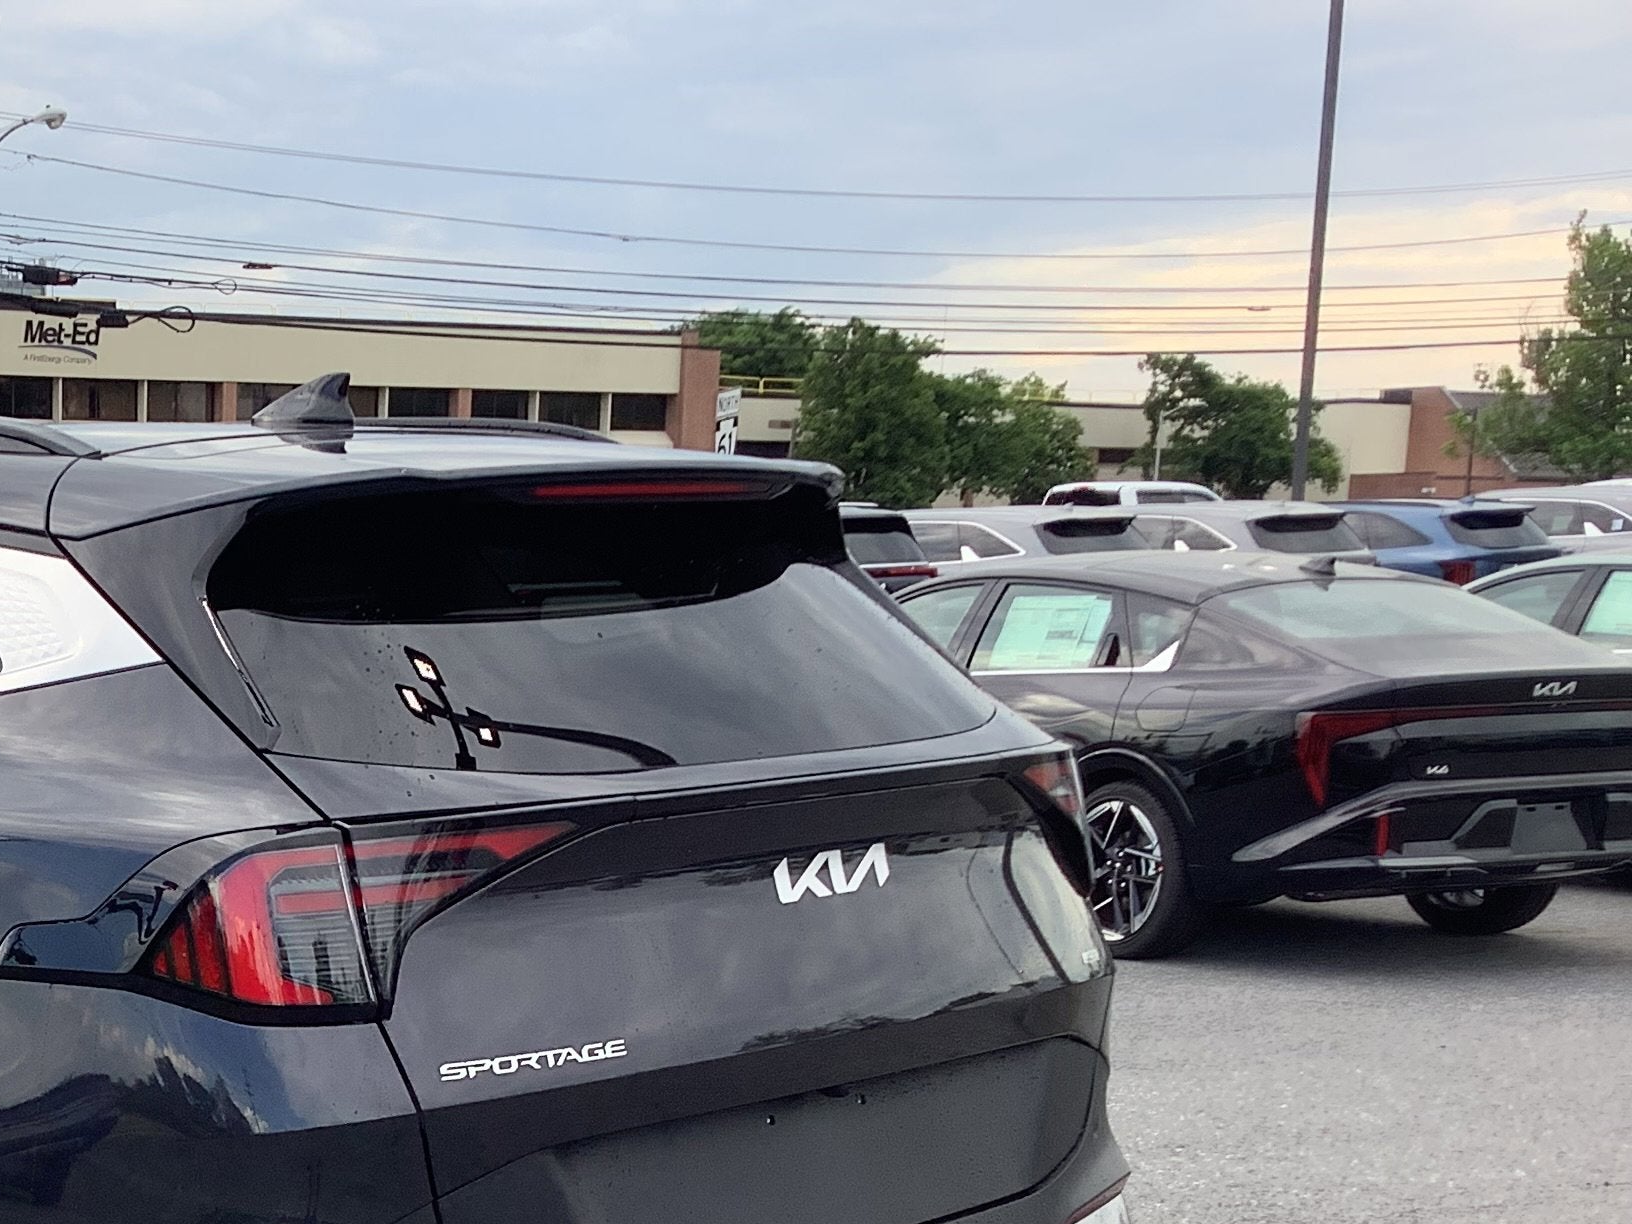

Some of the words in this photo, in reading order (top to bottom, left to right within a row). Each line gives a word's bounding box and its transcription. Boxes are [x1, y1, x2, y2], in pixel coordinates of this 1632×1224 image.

[23, 319, 100, 346] Met-Ed
[1532, 681, 1578, 697] KIA
[773, 842, 890, 905] KIA
[440, 1038, 628, 1082] SPORTAGE
